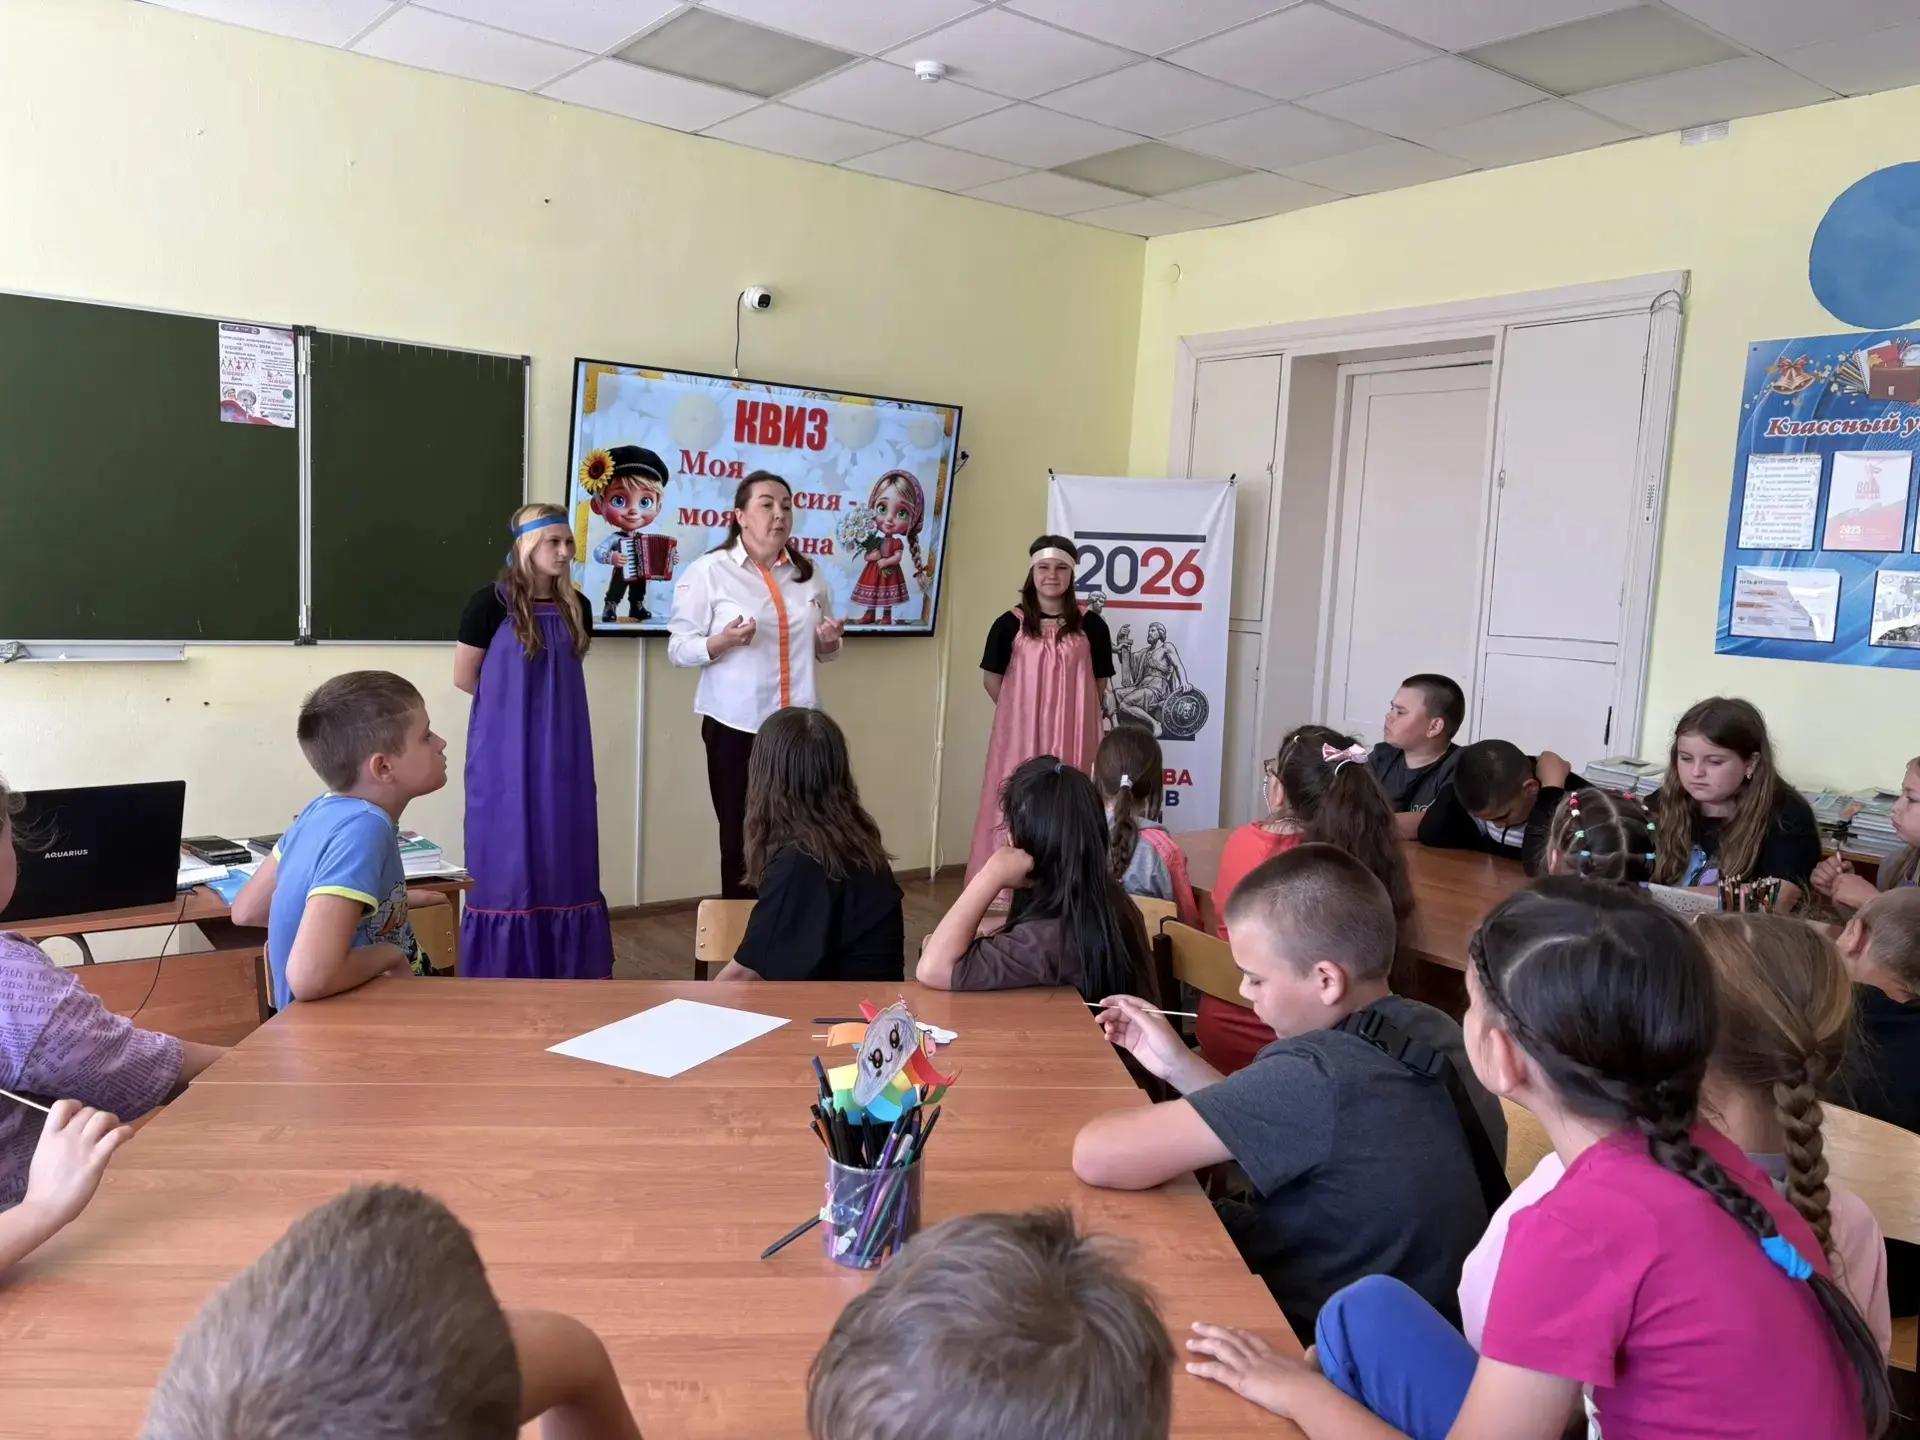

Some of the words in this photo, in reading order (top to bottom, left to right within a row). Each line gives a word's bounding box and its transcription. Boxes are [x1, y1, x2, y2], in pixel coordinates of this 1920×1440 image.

[734, 399, 829, 451] КВИЗ
[1764, 412, 1900, 437] Классный
[678, 449, 745, 479] Моя
[793, 491, 842, 512] сия
[678, 508, 736, 528] моя
[790, 537, 834, 555] ана
[1075, 545, 1205, 596] 2026
[44, 849, 88, 859] AQUARIUS
